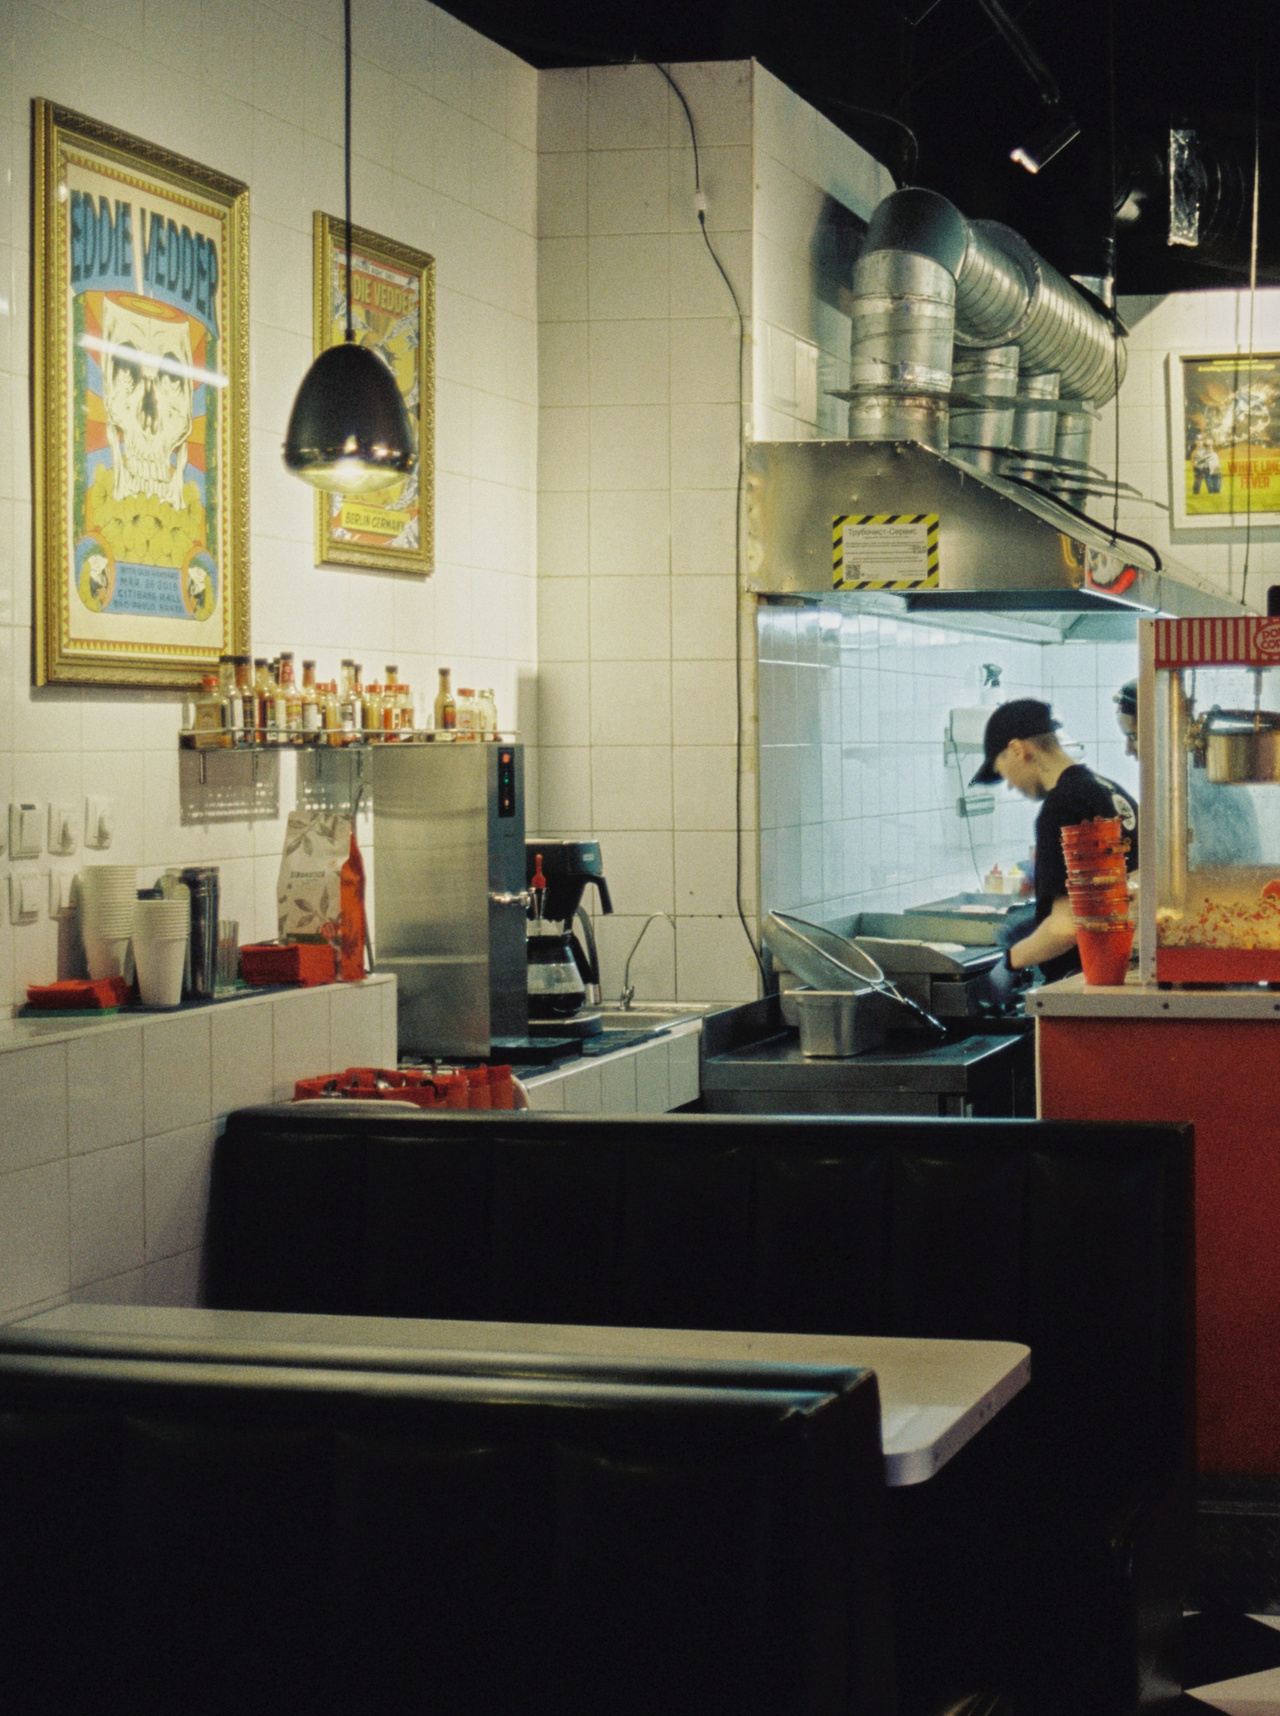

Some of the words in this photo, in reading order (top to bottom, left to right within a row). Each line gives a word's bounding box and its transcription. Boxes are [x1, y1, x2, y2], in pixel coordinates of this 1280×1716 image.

[70, 189, 132, 284] EDDIE
[140, 207, 219, 322] VEDDER
[339, 268, 371, 304] EDIE
[373, 280, 416, 317] VEDDER
[1227, 460, 1258, 474] WHITE
[1261, 459, 1280, 472] LINE
[1240, 475, 1270, 489] FEVER
[345, 512, 371, 526] BERLIN
